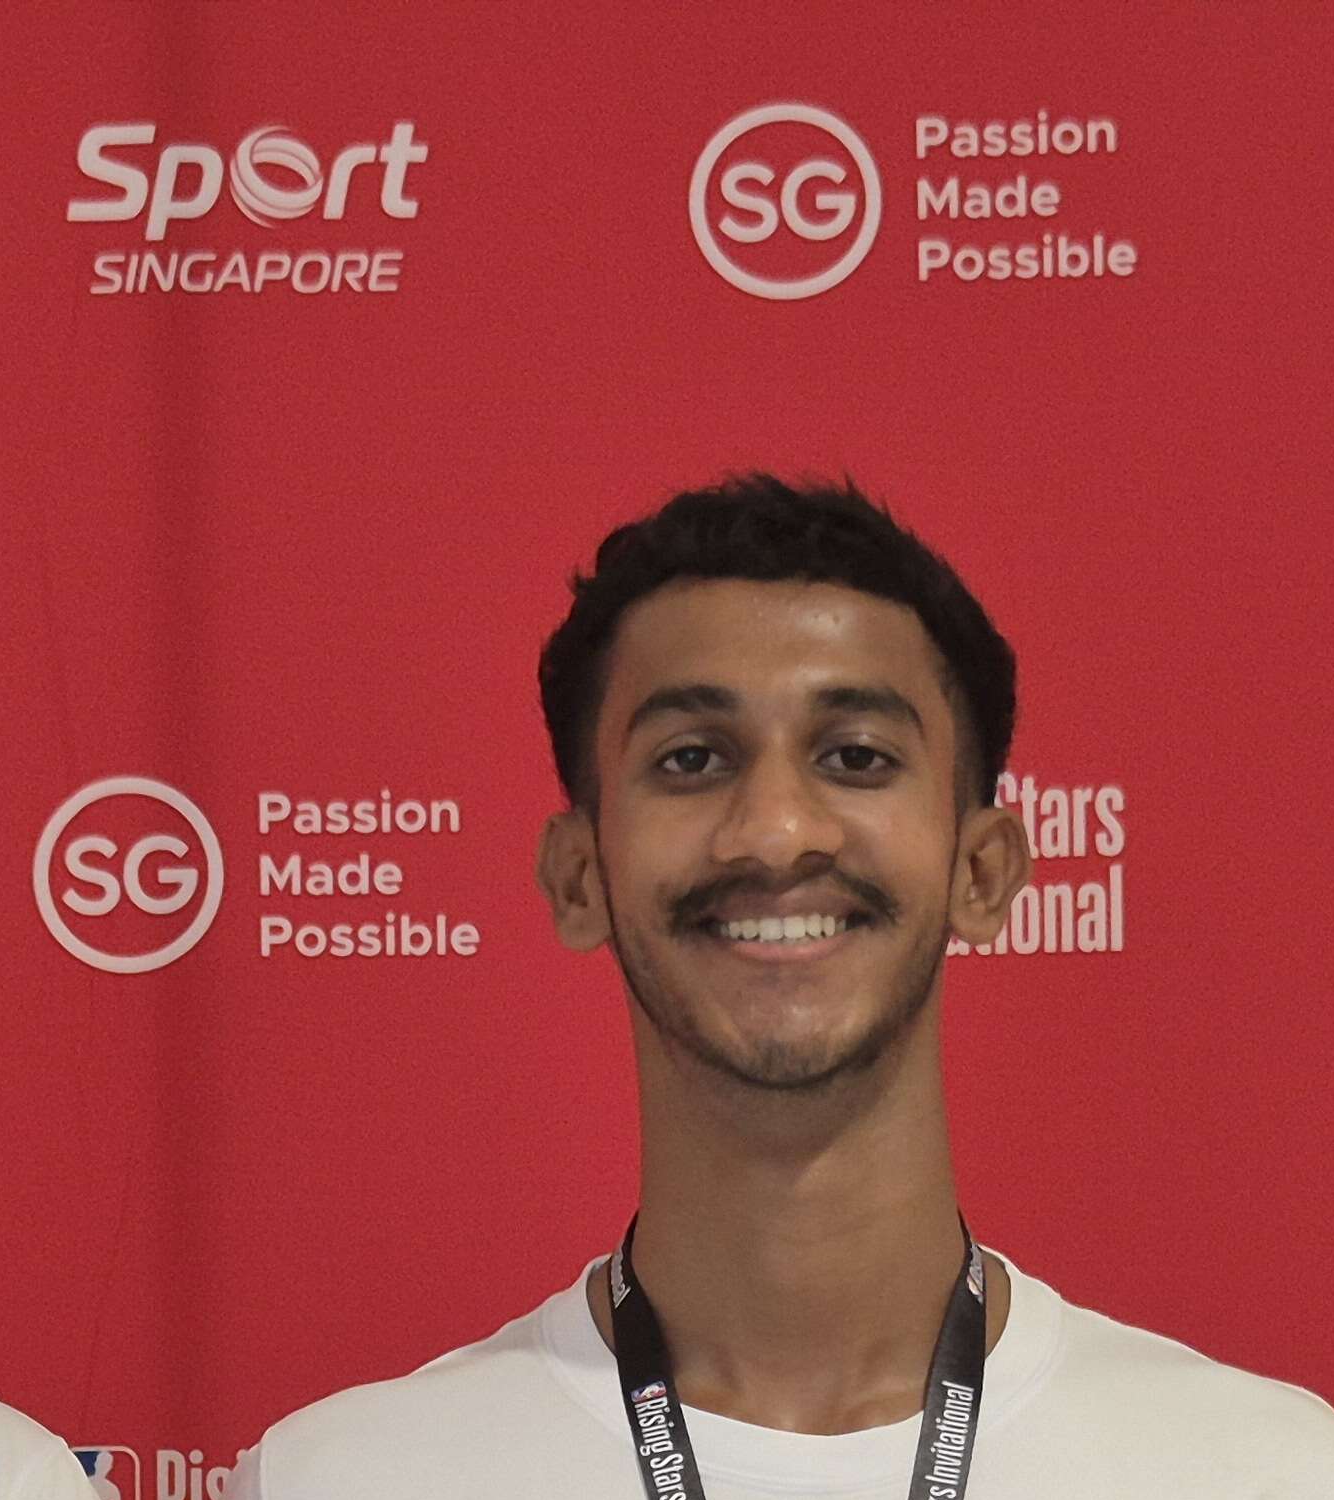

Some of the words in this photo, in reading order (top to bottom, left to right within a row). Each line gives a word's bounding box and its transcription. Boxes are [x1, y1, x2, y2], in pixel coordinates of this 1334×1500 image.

[915, 113, 1117, 159] Passion
[67, 122, 428, 240] Sport
[718, 163, 857, 243] SG
[917, 176, 1059, 218] Made
[91, 251, 403, 293] SINGAPORE
[917, 234, 1138, 282] Possible
[259, 790, 461, 834] Passion
[61, 835, 199, 916] SG
[260, 855, 403, 895] Made
[260, 914, 481, 958] Possible
[634, 1397, 674, 1456] Rising
[925, 1380, 975, 1486] Invitational
